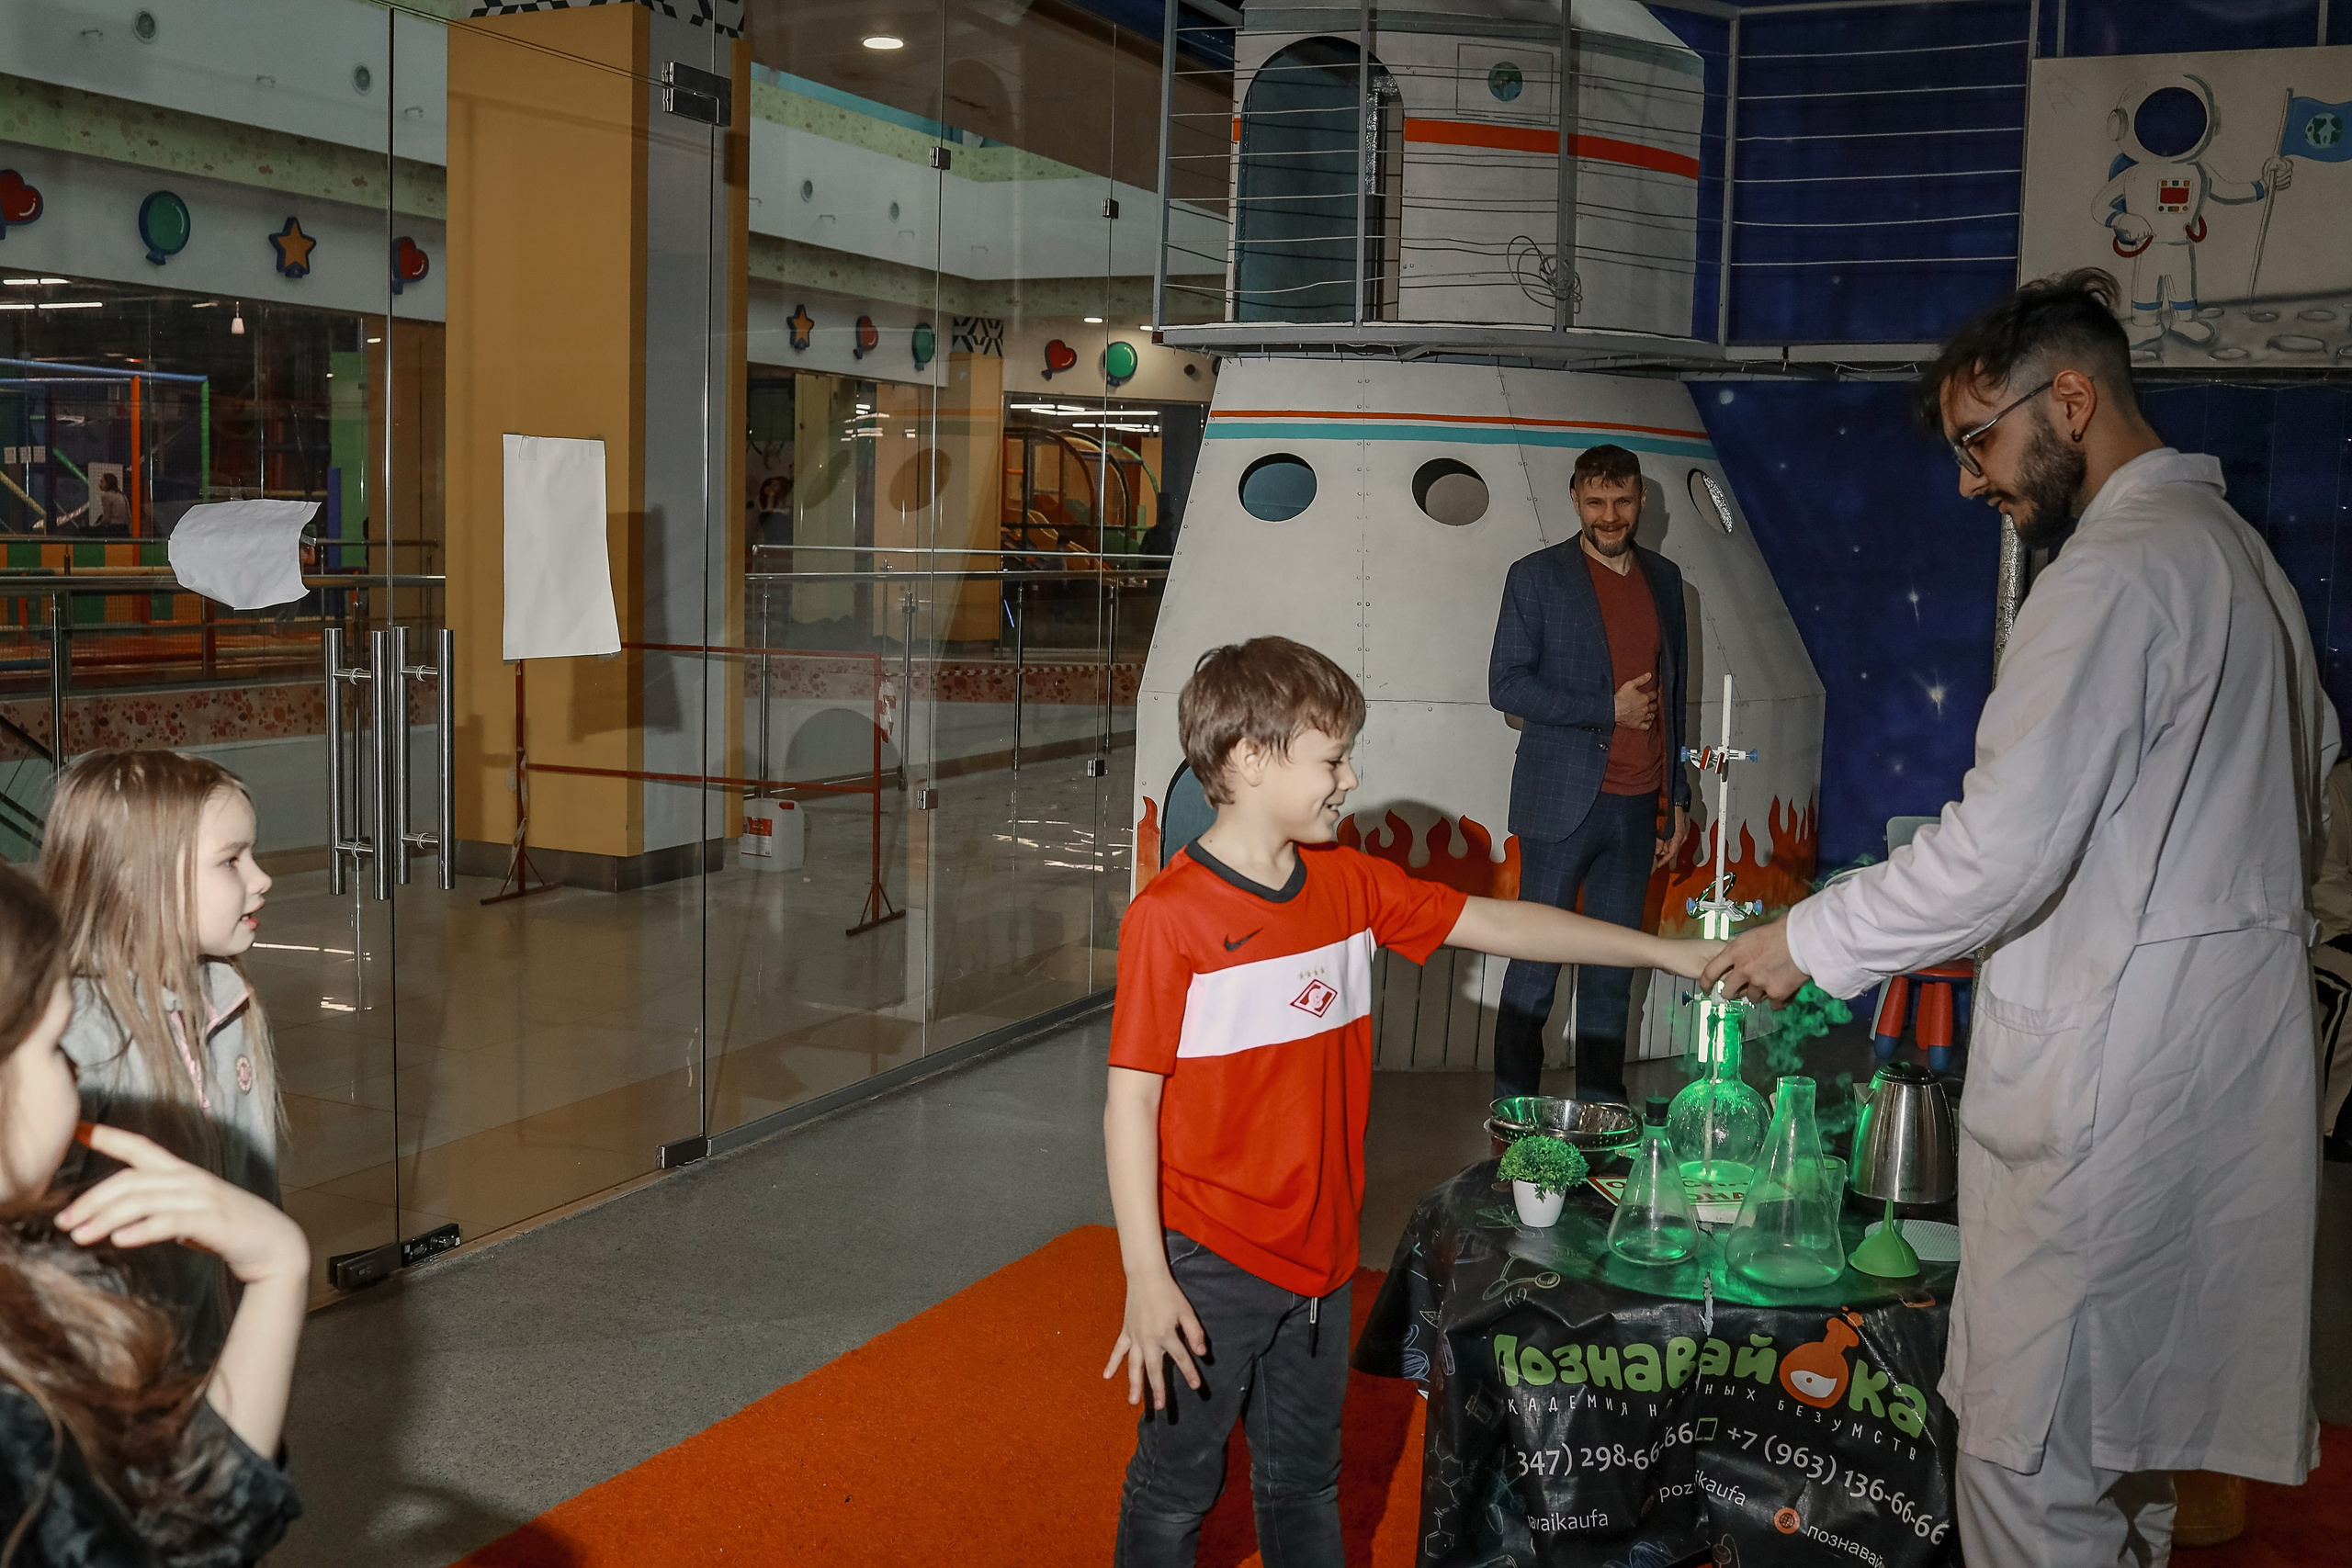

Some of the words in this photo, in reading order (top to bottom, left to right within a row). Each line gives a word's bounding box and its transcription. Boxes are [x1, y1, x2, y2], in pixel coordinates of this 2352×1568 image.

[1508, 1393, 1629, 1416] КАДЕМИЯ
[1777, 1399, 1917, 1461] БЕЗУМСТВ
[1516, 1441, 1573, 1477] 347)
[1726, 1427, 1758, 1450] +7
[1763, 1434, 1838, 1485] (963)
[1843, 1470, 1951, 1546] 136-66-66
